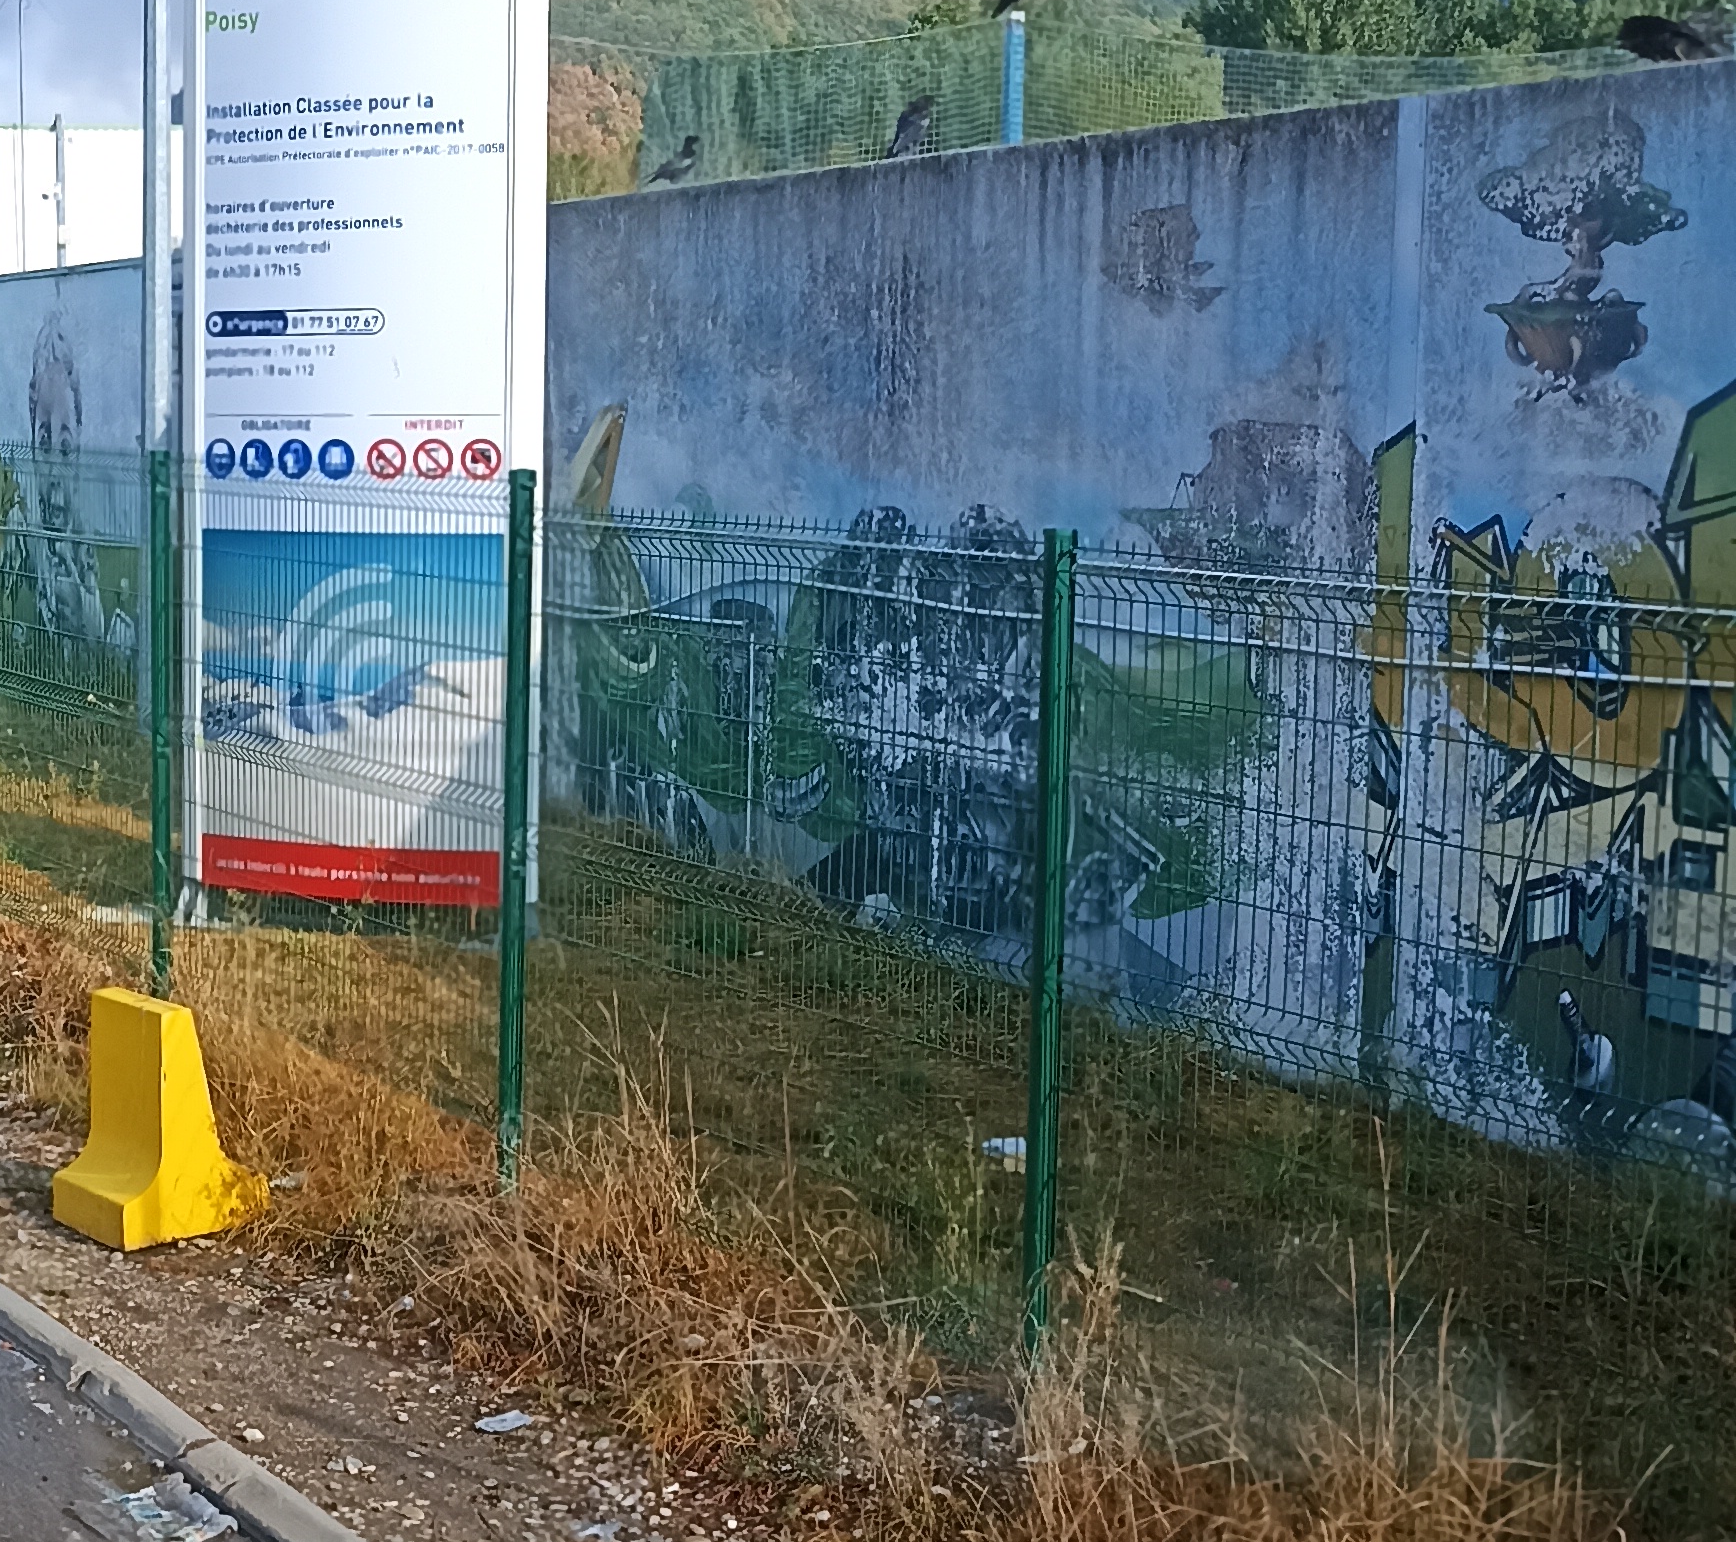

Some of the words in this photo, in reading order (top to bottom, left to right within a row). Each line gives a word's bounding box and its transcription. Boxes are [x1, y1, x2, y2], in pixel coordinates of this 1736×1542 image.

[204, 8, 259, 35] Poisy
[206, 99, 292, 120] Installation
[296, 93, 363, 115] Classée
[368, 96, 411, 114] pour
[416, 91, 434, 109] la
[206, 125, 283, 145] Protection
[287, 124, 307, 141] de
[312, 117, 465, 140] l'Environnement
[206, 200, 256, 215] horaires
[258, 198, 335, 214] d'ouverture
[271, 219, 295, 234] des
[297, 216, 404, 234] professionnels
[274, 239, 331, 255] vendredi
[263, 263, 302, 278] 17h15
[308, 316, 324, 329] 77
[344, 315, 360, 328] 07
[363, 315, 379, 328] 67
